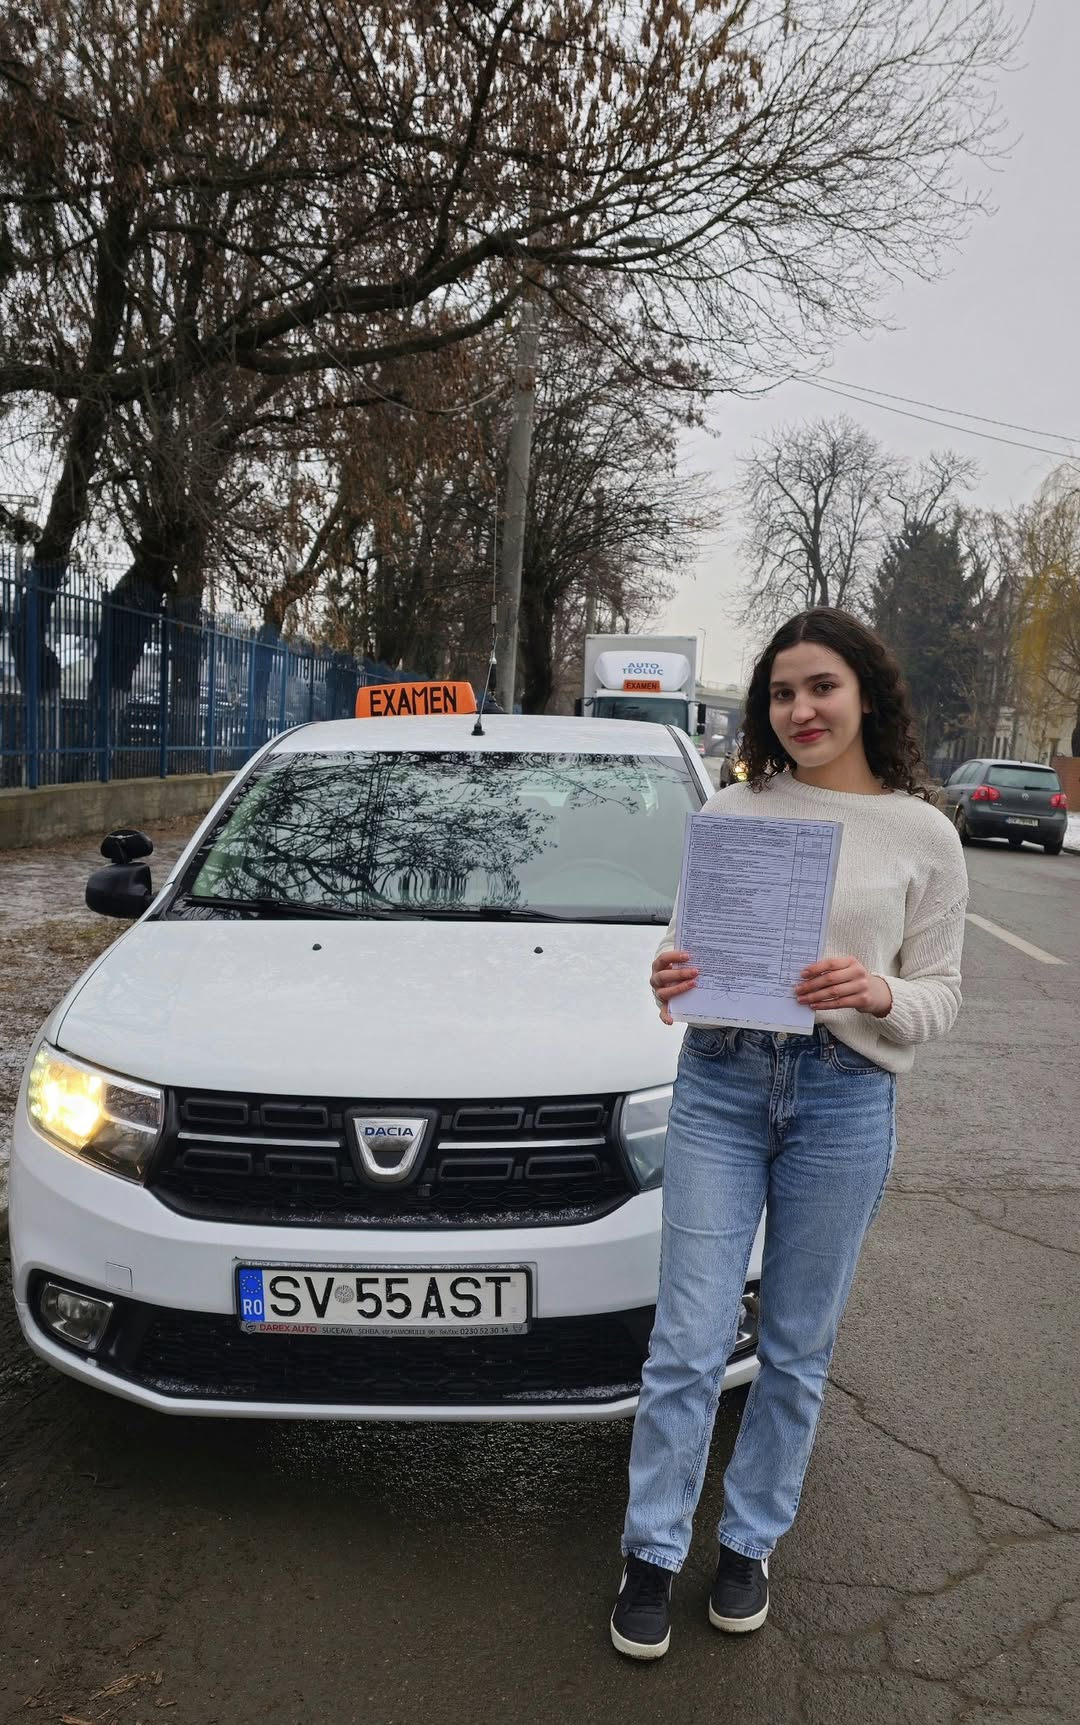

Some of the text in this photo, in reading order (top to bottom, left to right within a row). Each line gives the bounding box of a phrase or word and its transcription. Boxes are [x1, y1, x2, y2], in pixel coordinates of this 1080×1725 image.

[369, 685, 458, 717] EXAMEN
[364, 1127, 414, 1136] DACIA
[269, 1275, 511, 1319] SV 55 AST
[243, 1299, 262, 1316] RO
[259, 1323, 290, 1332] DAREX
[291, 1325, 318, 1334] AUTO
[322, 1326, 353, 1335] SUCEAVA
[460, 1327, 479, 1335] 0230
